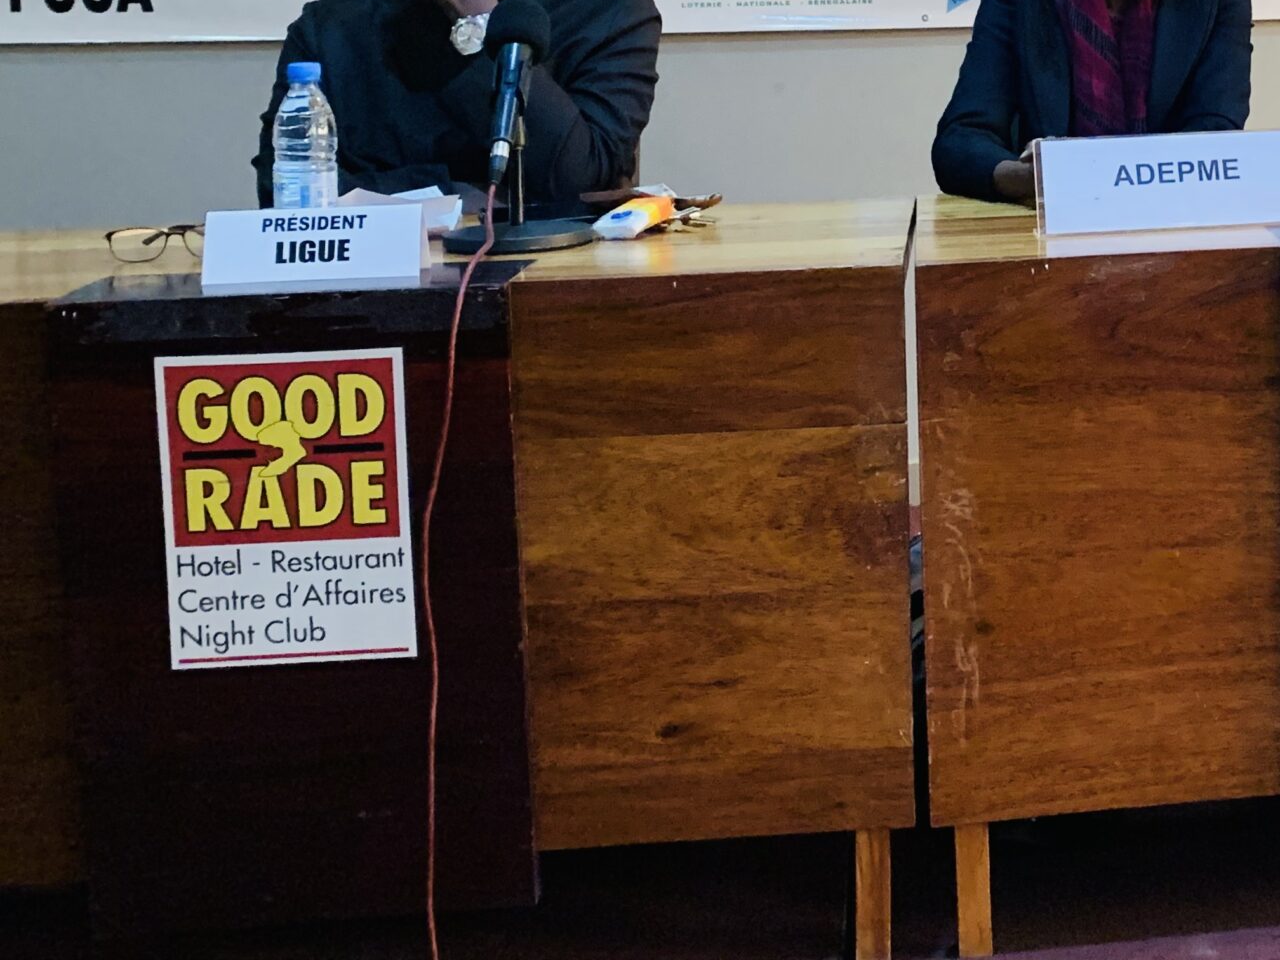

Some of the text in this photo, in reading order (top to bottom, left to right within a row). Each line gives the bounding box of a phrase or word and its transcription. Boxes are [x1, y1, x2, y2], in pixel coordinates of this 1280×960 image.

[1113, 157, 1241, 188] ADEPME
[261, 213, 367, 233] PRÉSIDENT
[274, 238, 350, 265] LIGUE
[176, 372, 386, 445] GOOD
[182, 460, 388, 533] RADE
[176, 548, 242, 578] Hotel
[271, 546, 405, 573] Restaurant
[178, 578, 407, 614] Centre d'Affaires
[180, 615, 327, 654] Night Club
